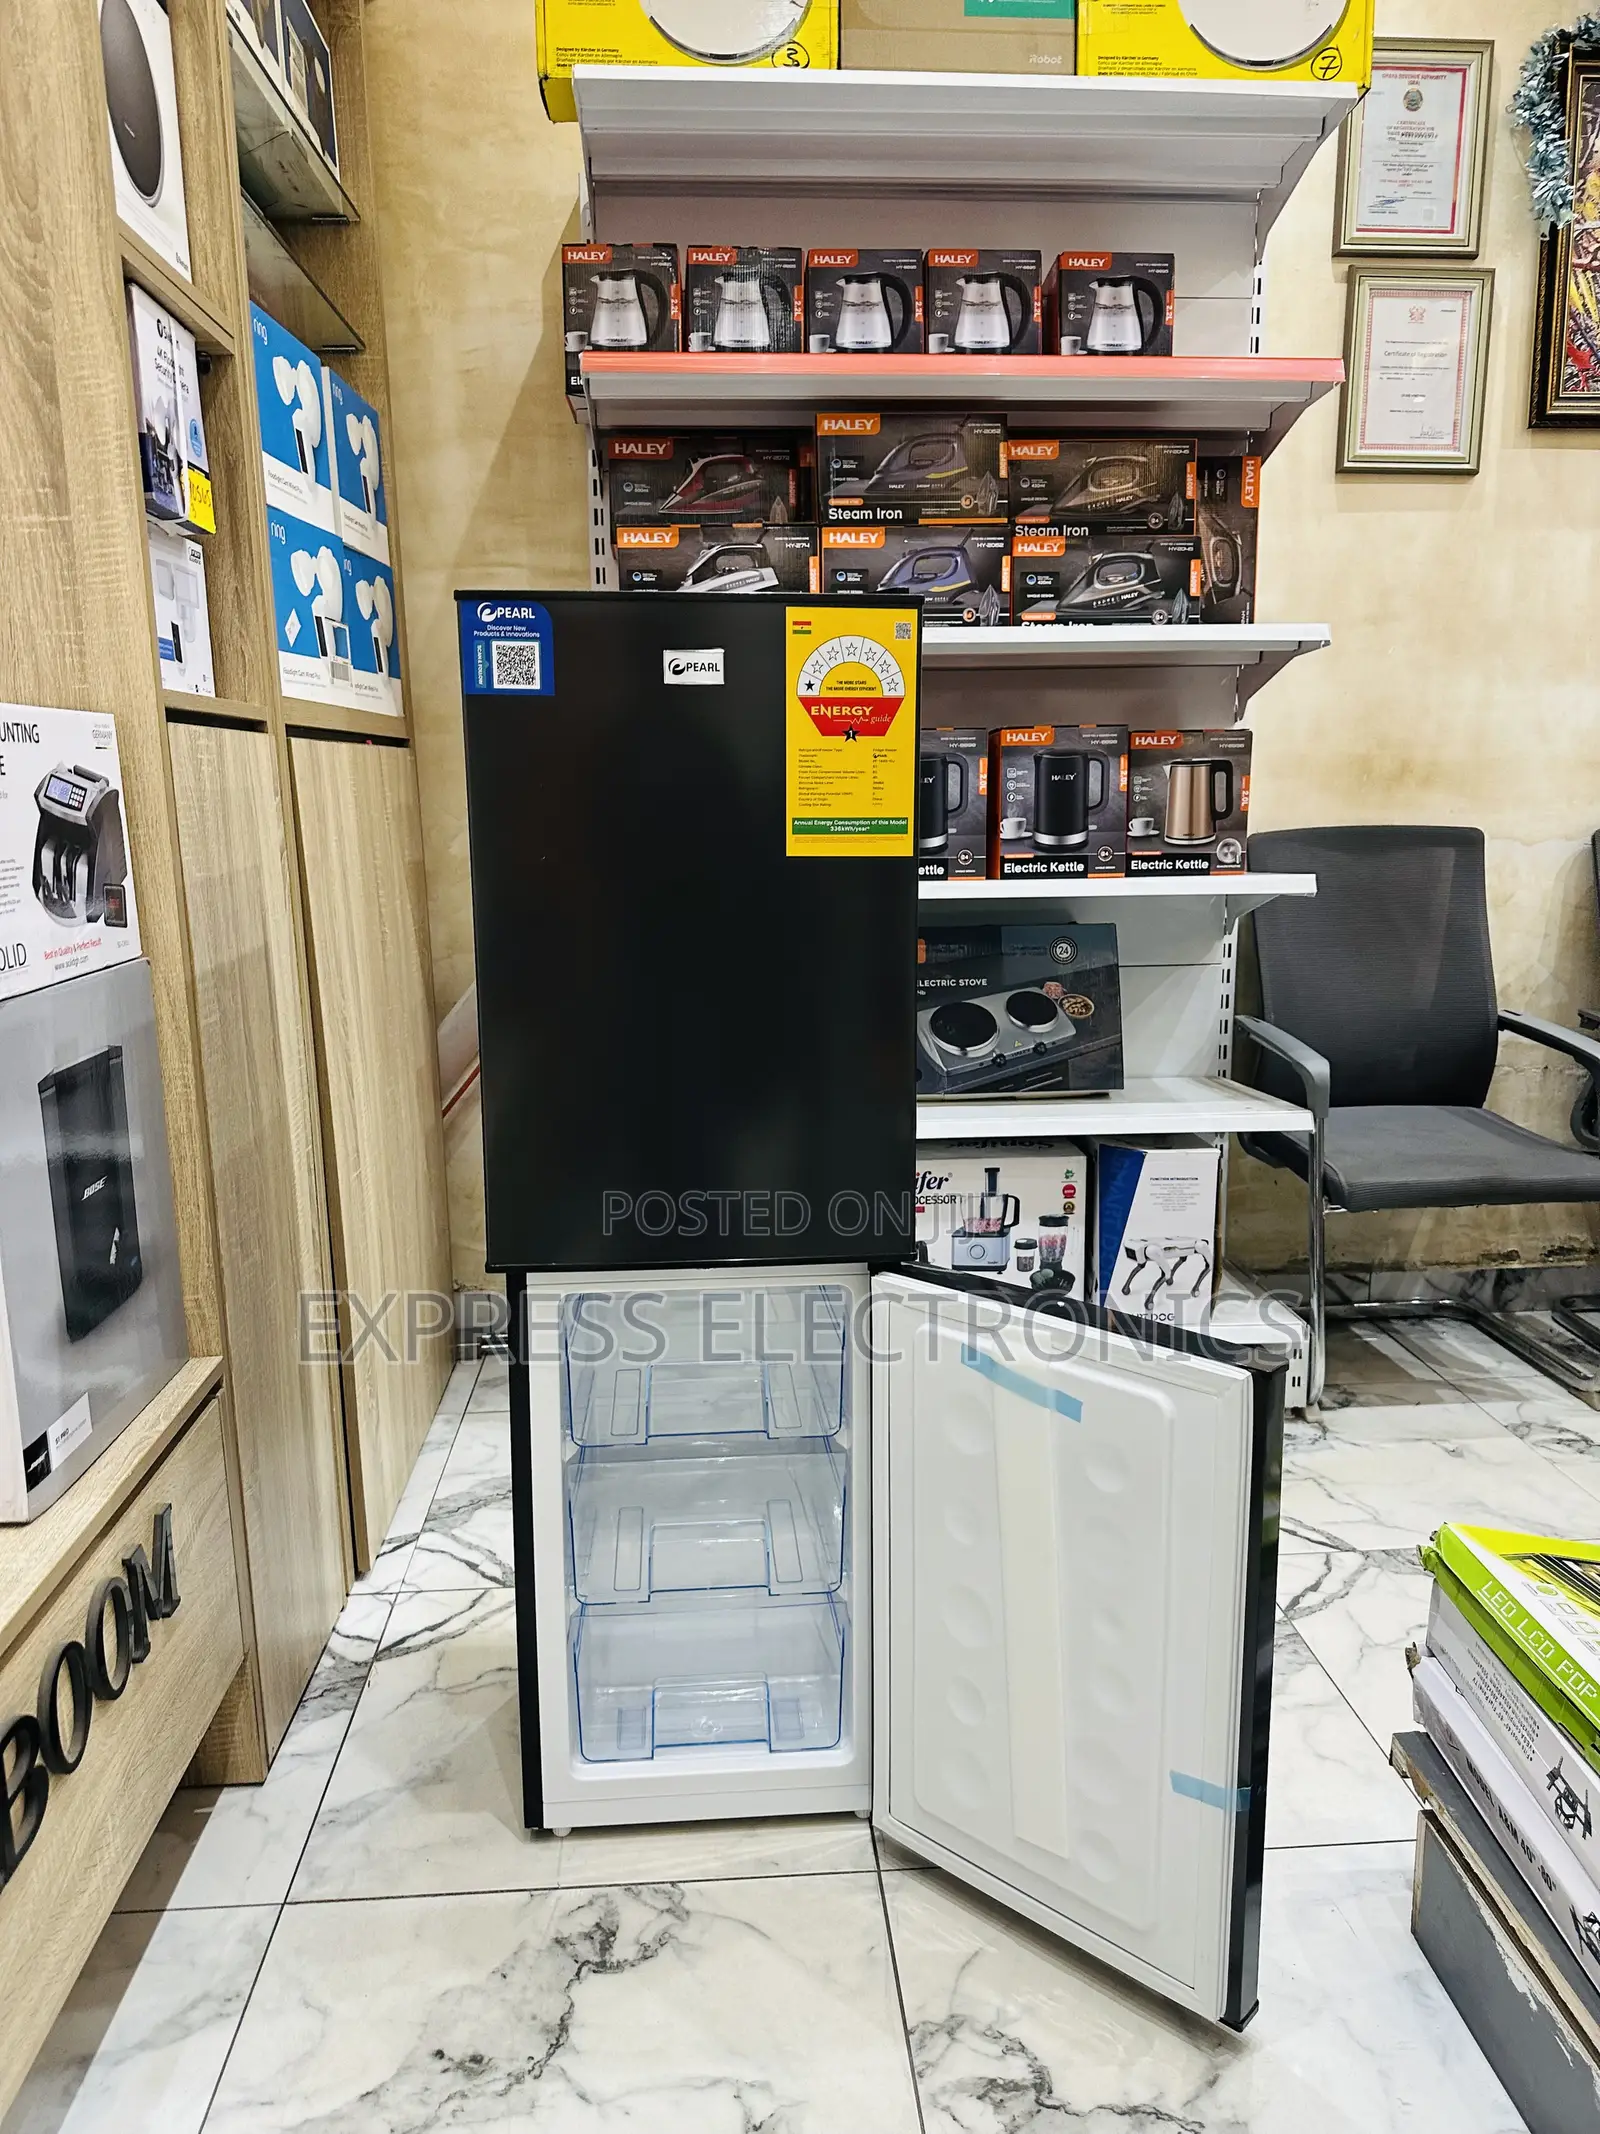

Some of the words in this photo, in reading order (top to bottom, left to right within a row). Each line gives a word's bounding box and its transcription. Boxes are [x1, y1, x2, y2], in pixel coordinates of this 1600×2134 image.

[1029, 54, 1062, 65] iRobot
[1322, 55, 1337, 70] 7
[568, 251, 606, 261] HALEY
[692, 252, 731, 262] HALEY
[814, 254, 852, 264] HALEY
[934, 254, 973, 264] HALEY
[1068, 258, 1105, 267] HALEY
[253, 316, 268, 346] ring
[332, 381, 343, 406] ring
[823, 419, 874, 430] HALEY
[614, 443, 666, 455] HALEY
[1011, 446, 1053, 456] HALEY
[1244, 460, 1255, 502] HALEY
[829, 508, 874, 519] Steam
[877, 508, 903, 519] Iron
[271, 519, 286, 545] ring
[1015, 526, 1061, 536] Steam
[1063, 525, 1089, 536] Iron
[623, 532, 673, 543] HALEY
[829, 532, 878, 544] HALEY
[1017, 543, 1060, 553] HALEY
[1121, 591, 1139, 600] HALEY
[497, 607, 535, 618] PEARL
[686, 661, 721, 672] PEARL
[870, 714, 892, 724] guide
[1006, 731, 1048, 743] HALEY
[1135, 735, 1177, 746] HALEY
[1240, 790, 1249, 807] 2.0L
[1004, 862, 1047, 874] Electric
[1050, 862, 1085, 873] Kettle
[1130, 860, 1176, 871] Electric
[1178, 859, 1209, 870] Kettle
[1058, 945, 1069, 956] 24
[917, 979, 957, 987] LECTRIC
[81, 1175, 108, 1201] BOSE
[1151, 1313, 1175, 1321] DOG
[1481, 1580, 1517, 1618] LED
[1517, 1618, 1555, 1658] LCD
[1556, 1659, 1597, 1698] PDP
[0, 1503, 181, 1895] BOOM
[1465, 1755, 1496, 1807] MODEL
